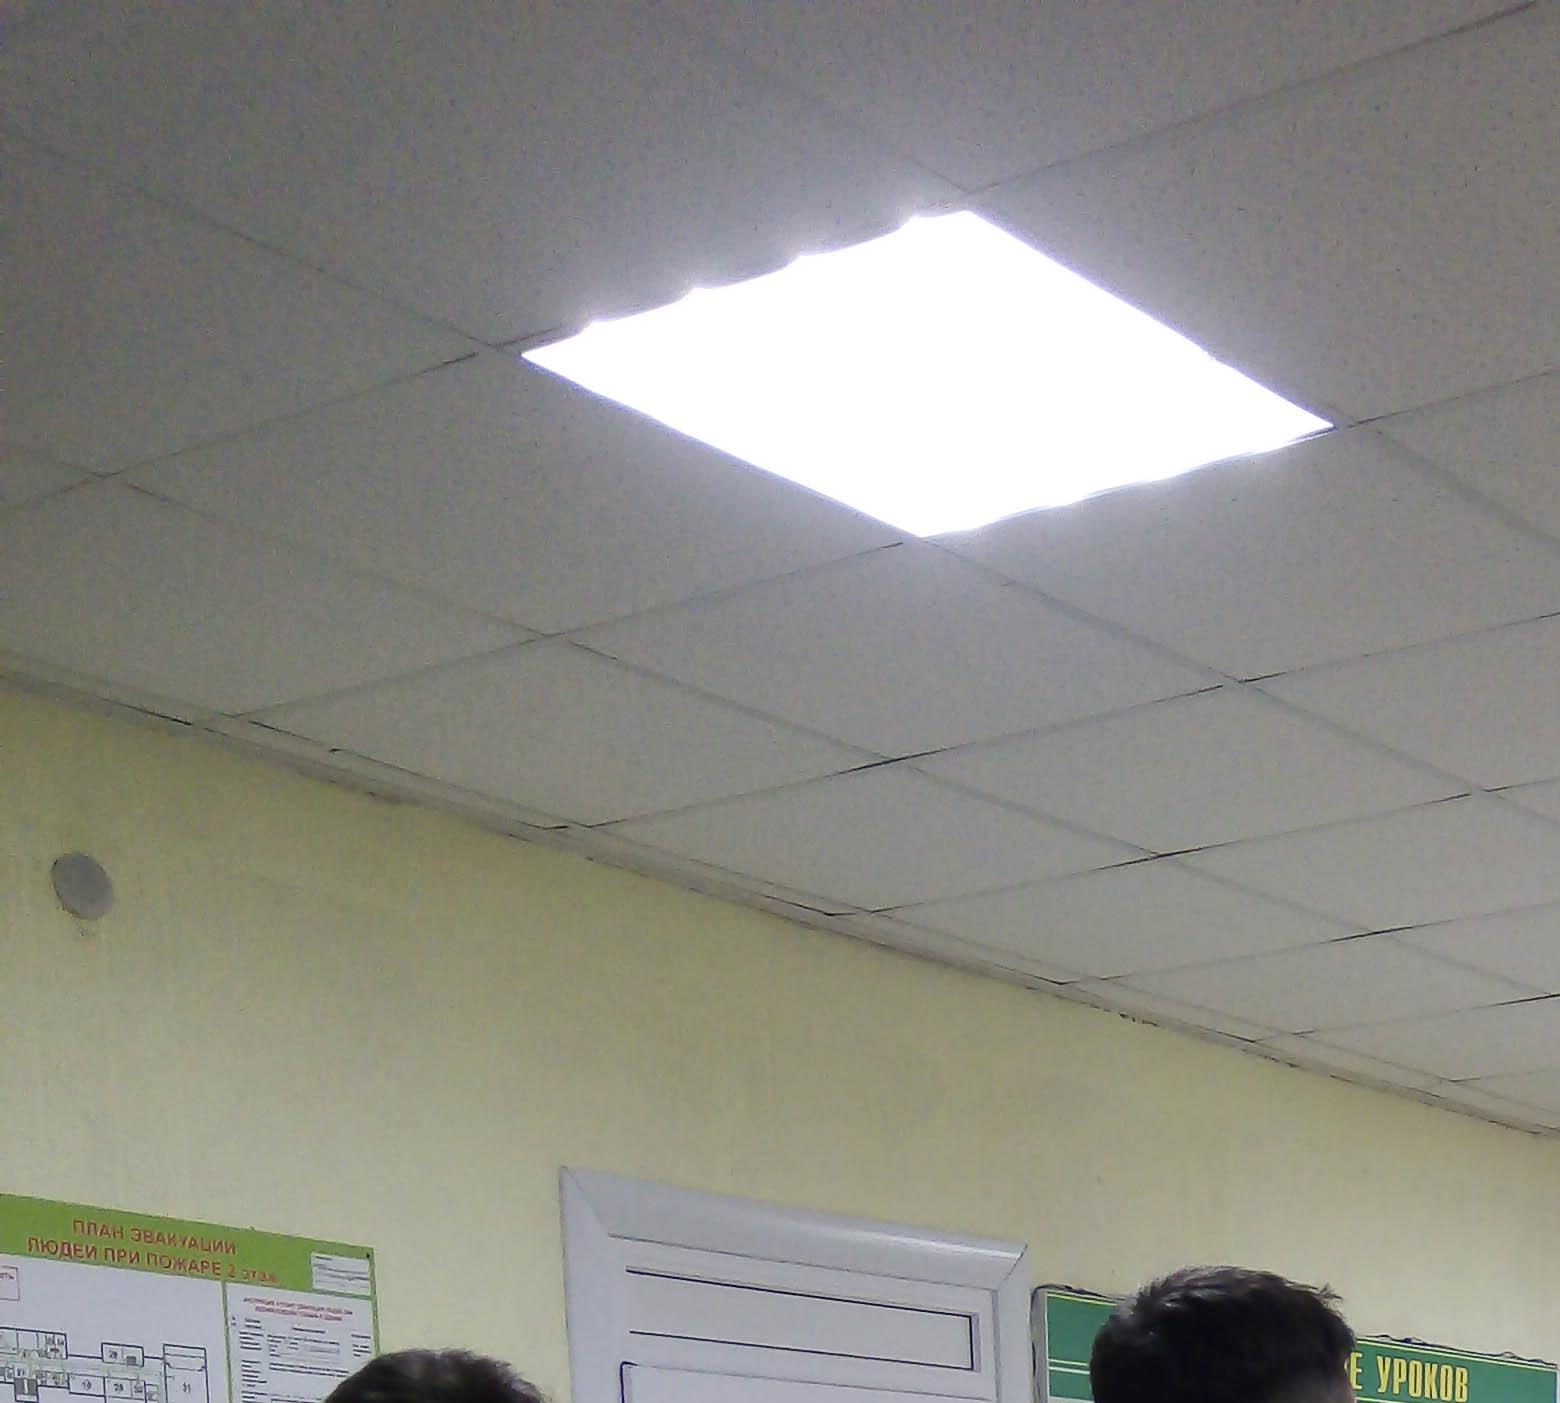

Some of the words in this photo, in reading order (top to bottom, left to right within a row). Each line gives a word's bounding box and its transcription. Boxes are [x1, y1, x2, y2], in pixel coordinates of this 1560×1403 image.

[73, 1219, 124, 1240] ПЛАН
[131, 1229, 236, 1255] ЭВАКУАЦИИ
[104, 1247, 140, 1265] ПРИ
[147, 1252, 222, 1276] ПОЖАРЕ
[228, 1263, 236, 1277] 2
[1376, 1354, 1470, 1403] УРОКОВ
